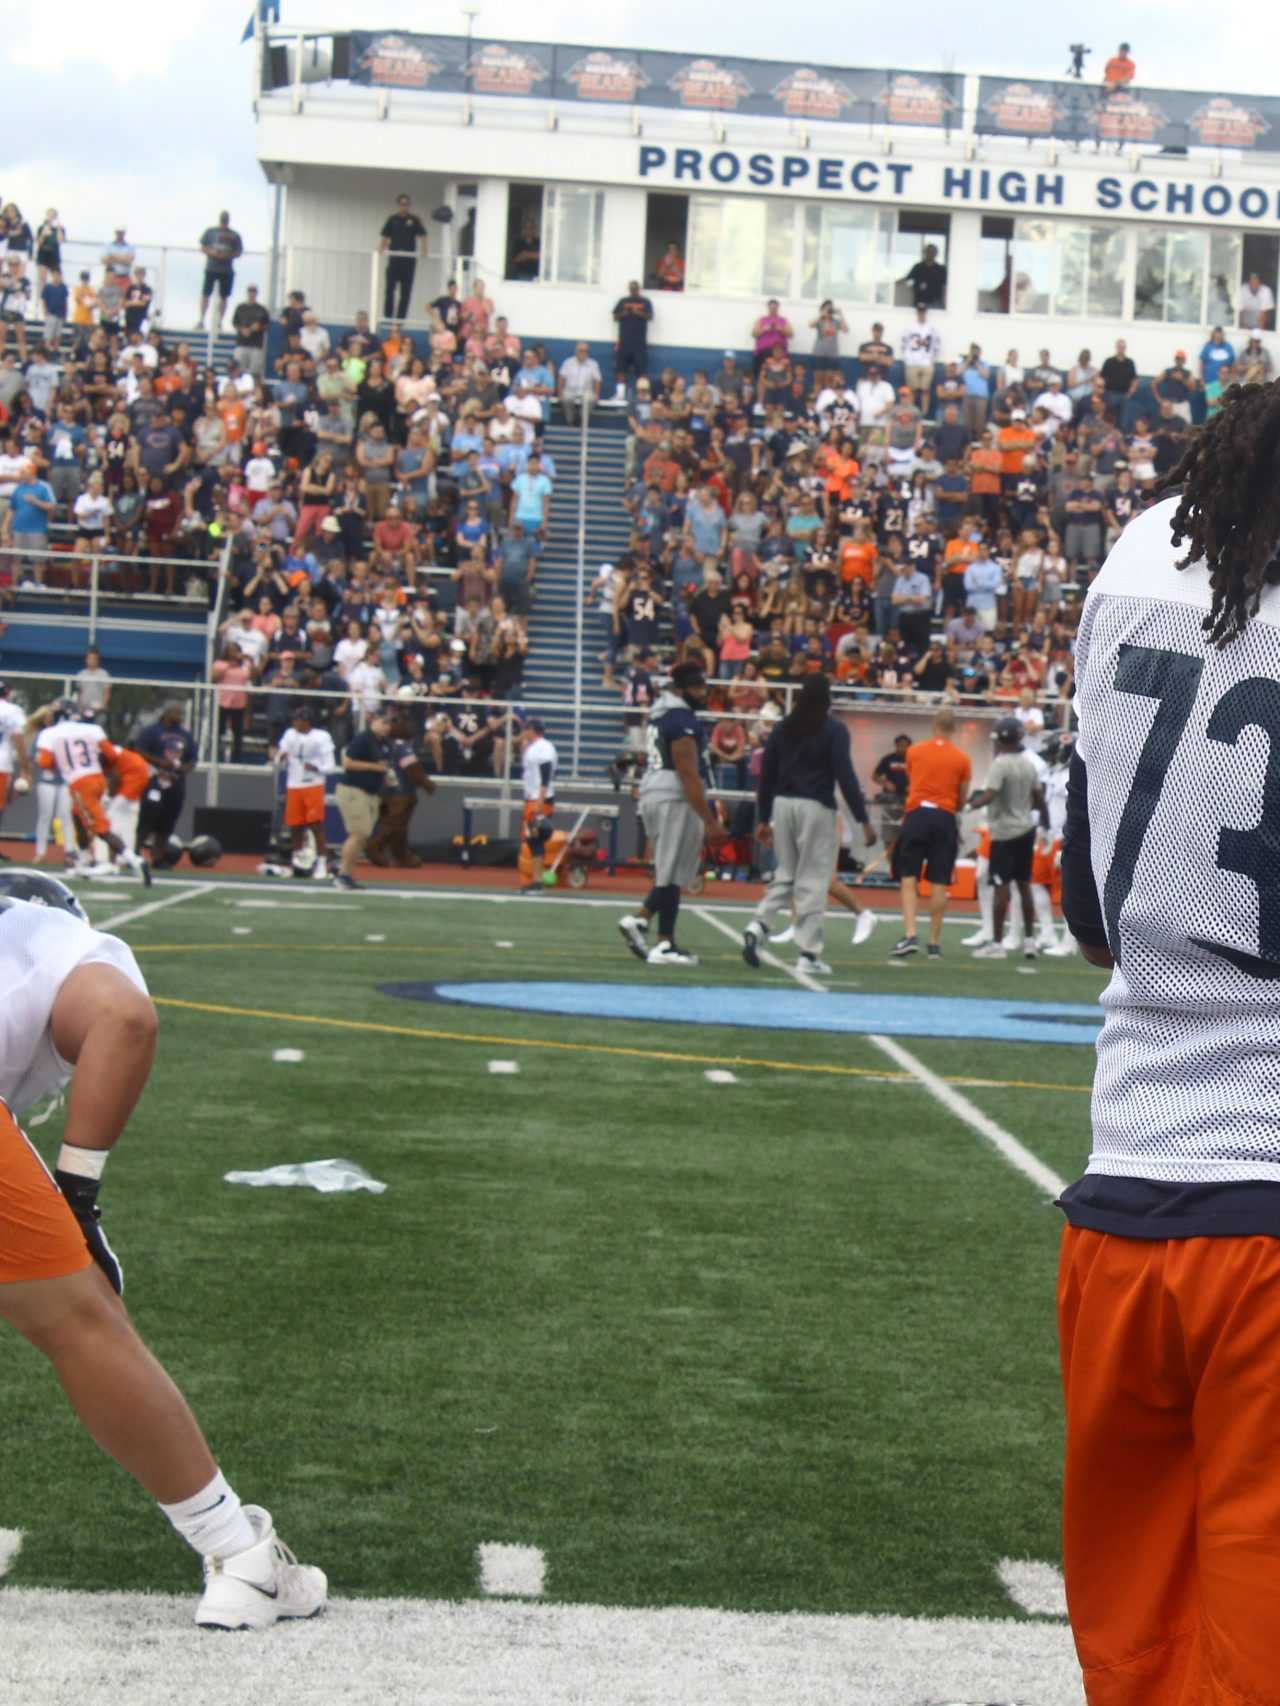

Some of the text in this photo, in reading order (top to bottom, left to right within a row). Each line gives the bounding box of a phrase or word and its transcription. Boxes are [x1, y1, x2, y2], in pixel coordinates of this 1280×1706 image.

[639, 146, 913, 194] PROSPECT
[943, 168, 1064, 205] HIGH
[633, 598, 655, 621] 54
[64, 739, 91, 768] 13
